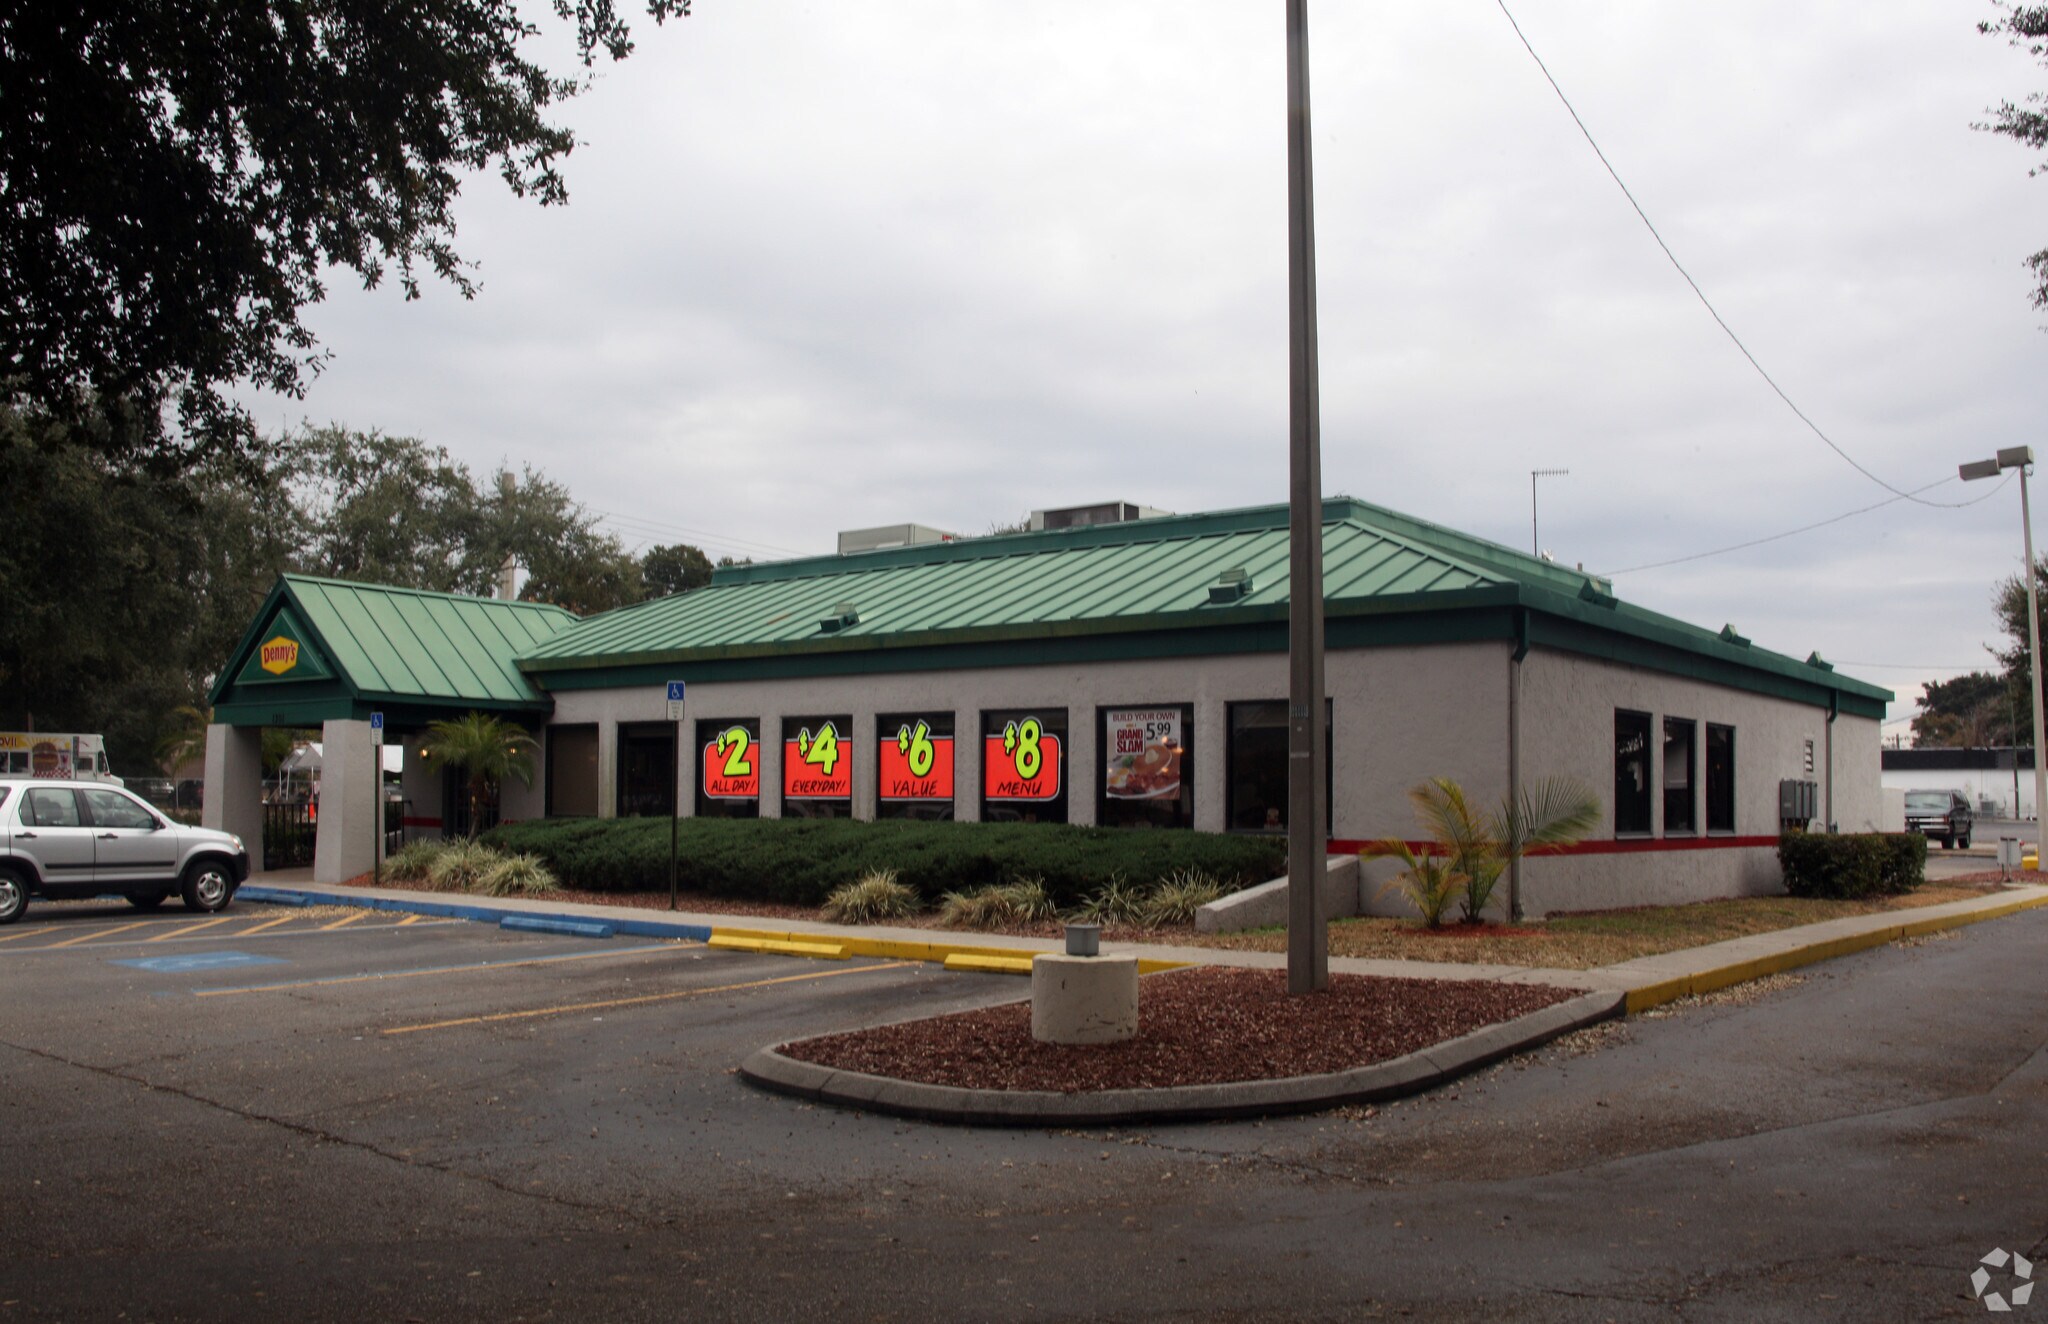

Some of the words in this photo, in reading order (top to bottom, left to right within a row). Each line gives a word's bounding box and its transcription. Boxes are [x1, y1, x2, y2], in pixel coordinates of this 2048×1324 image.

[263, 643, 296, 664] Denny's
[1112, 713, 1133, 721] BUILD
[1135, 712, 1155, 720] YOUR
[1156, 712, 1175, 720] OWN
[1117, 729, 1143, 740] GRAND
[1146, 722, 1171, 740] 5.99
[717, 728, 751, 776] $2
[799, 723, 838, 775] $4
[899, 721, 934, 777] $6
[1004, 718, 1042, 779] $8
[1117, 740, 1143, 753] SLAM
[711, 780, 728, 792] ALL
[732, 780, 755, 792] DAY!
[792, 780, 846, 793] EVERYDAY!
[893, 780, 938, 796] VALUE
[997, 782, 1042, 796] MENU
